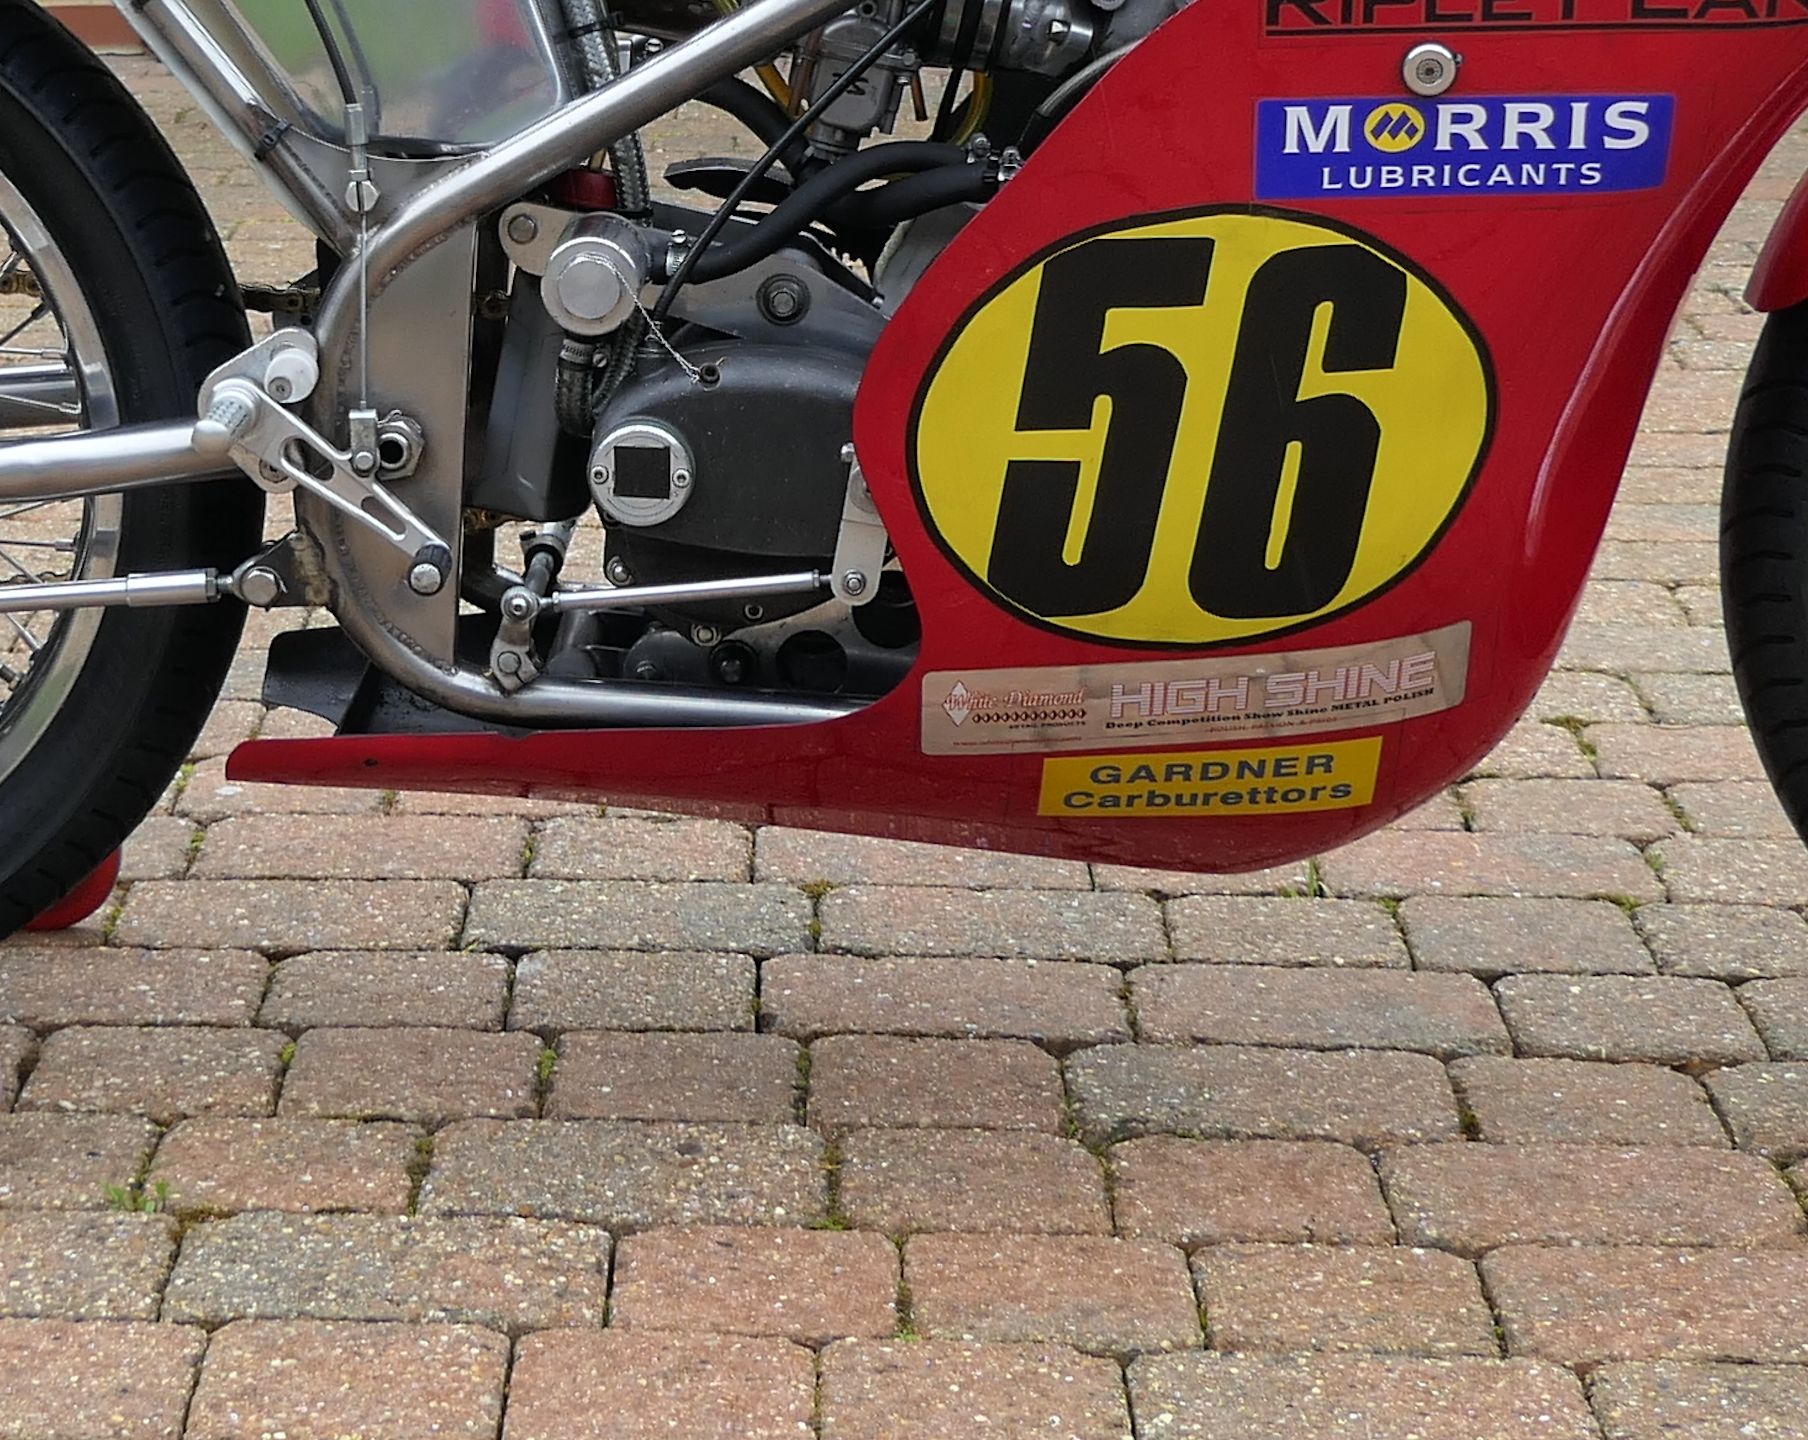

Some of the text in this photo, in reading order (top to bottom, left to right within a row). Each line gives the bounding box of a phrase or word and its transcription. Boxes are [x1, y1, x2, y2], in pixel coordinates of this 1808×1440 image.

[1282, 101, 1650, 154] MORRIS
[1321, 162, 1602, 190] LUBRICANTS
[987, 236, 1408, 619] 56
[1004, 687, 1087, 709] Diamond
[1111, 651, 1436, 718] HIGH SHINE
[1105, 686, 1435, 730] Deep Competition Show Shine METAL POLISH
[1088, 753, 1336, 785] GARDNER
[1063, 780, 1353, 810] Carburettors
